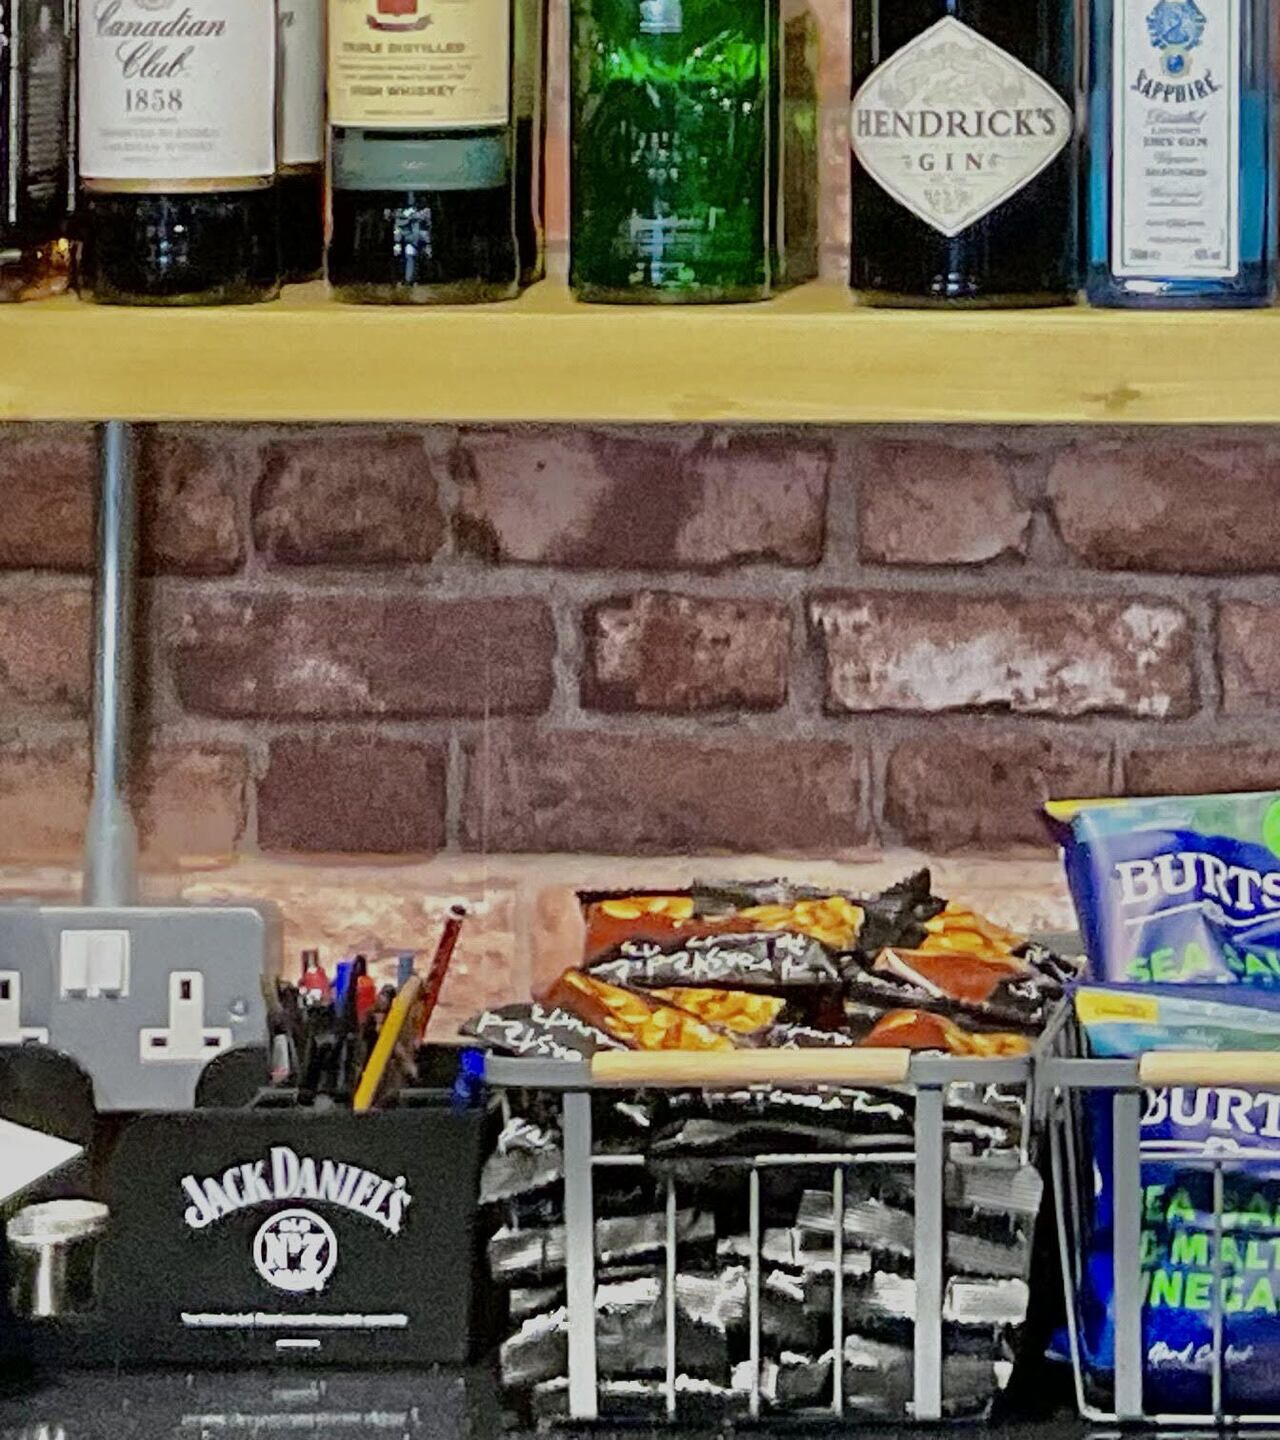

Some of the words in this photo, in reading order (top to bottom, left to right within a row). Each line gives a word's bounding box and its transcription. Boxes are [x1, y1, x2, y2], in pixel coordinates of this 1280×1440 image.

[115, 39, 195, 80] Club
[125, 88, 184, 113] 1858
[1130, 68, 1223, 104] SAPPHIRE
[856, 107, 1058, 138] HENDRICK'S
[919, 152, 983, 172] GIN
[1127, 942, 1209, 982] SEA
[180, 1159, 275, 1229] JACK
[270, 1145, 413, 1236] DANIEL'S
[1140, 1184, 1195, 1222] EA
